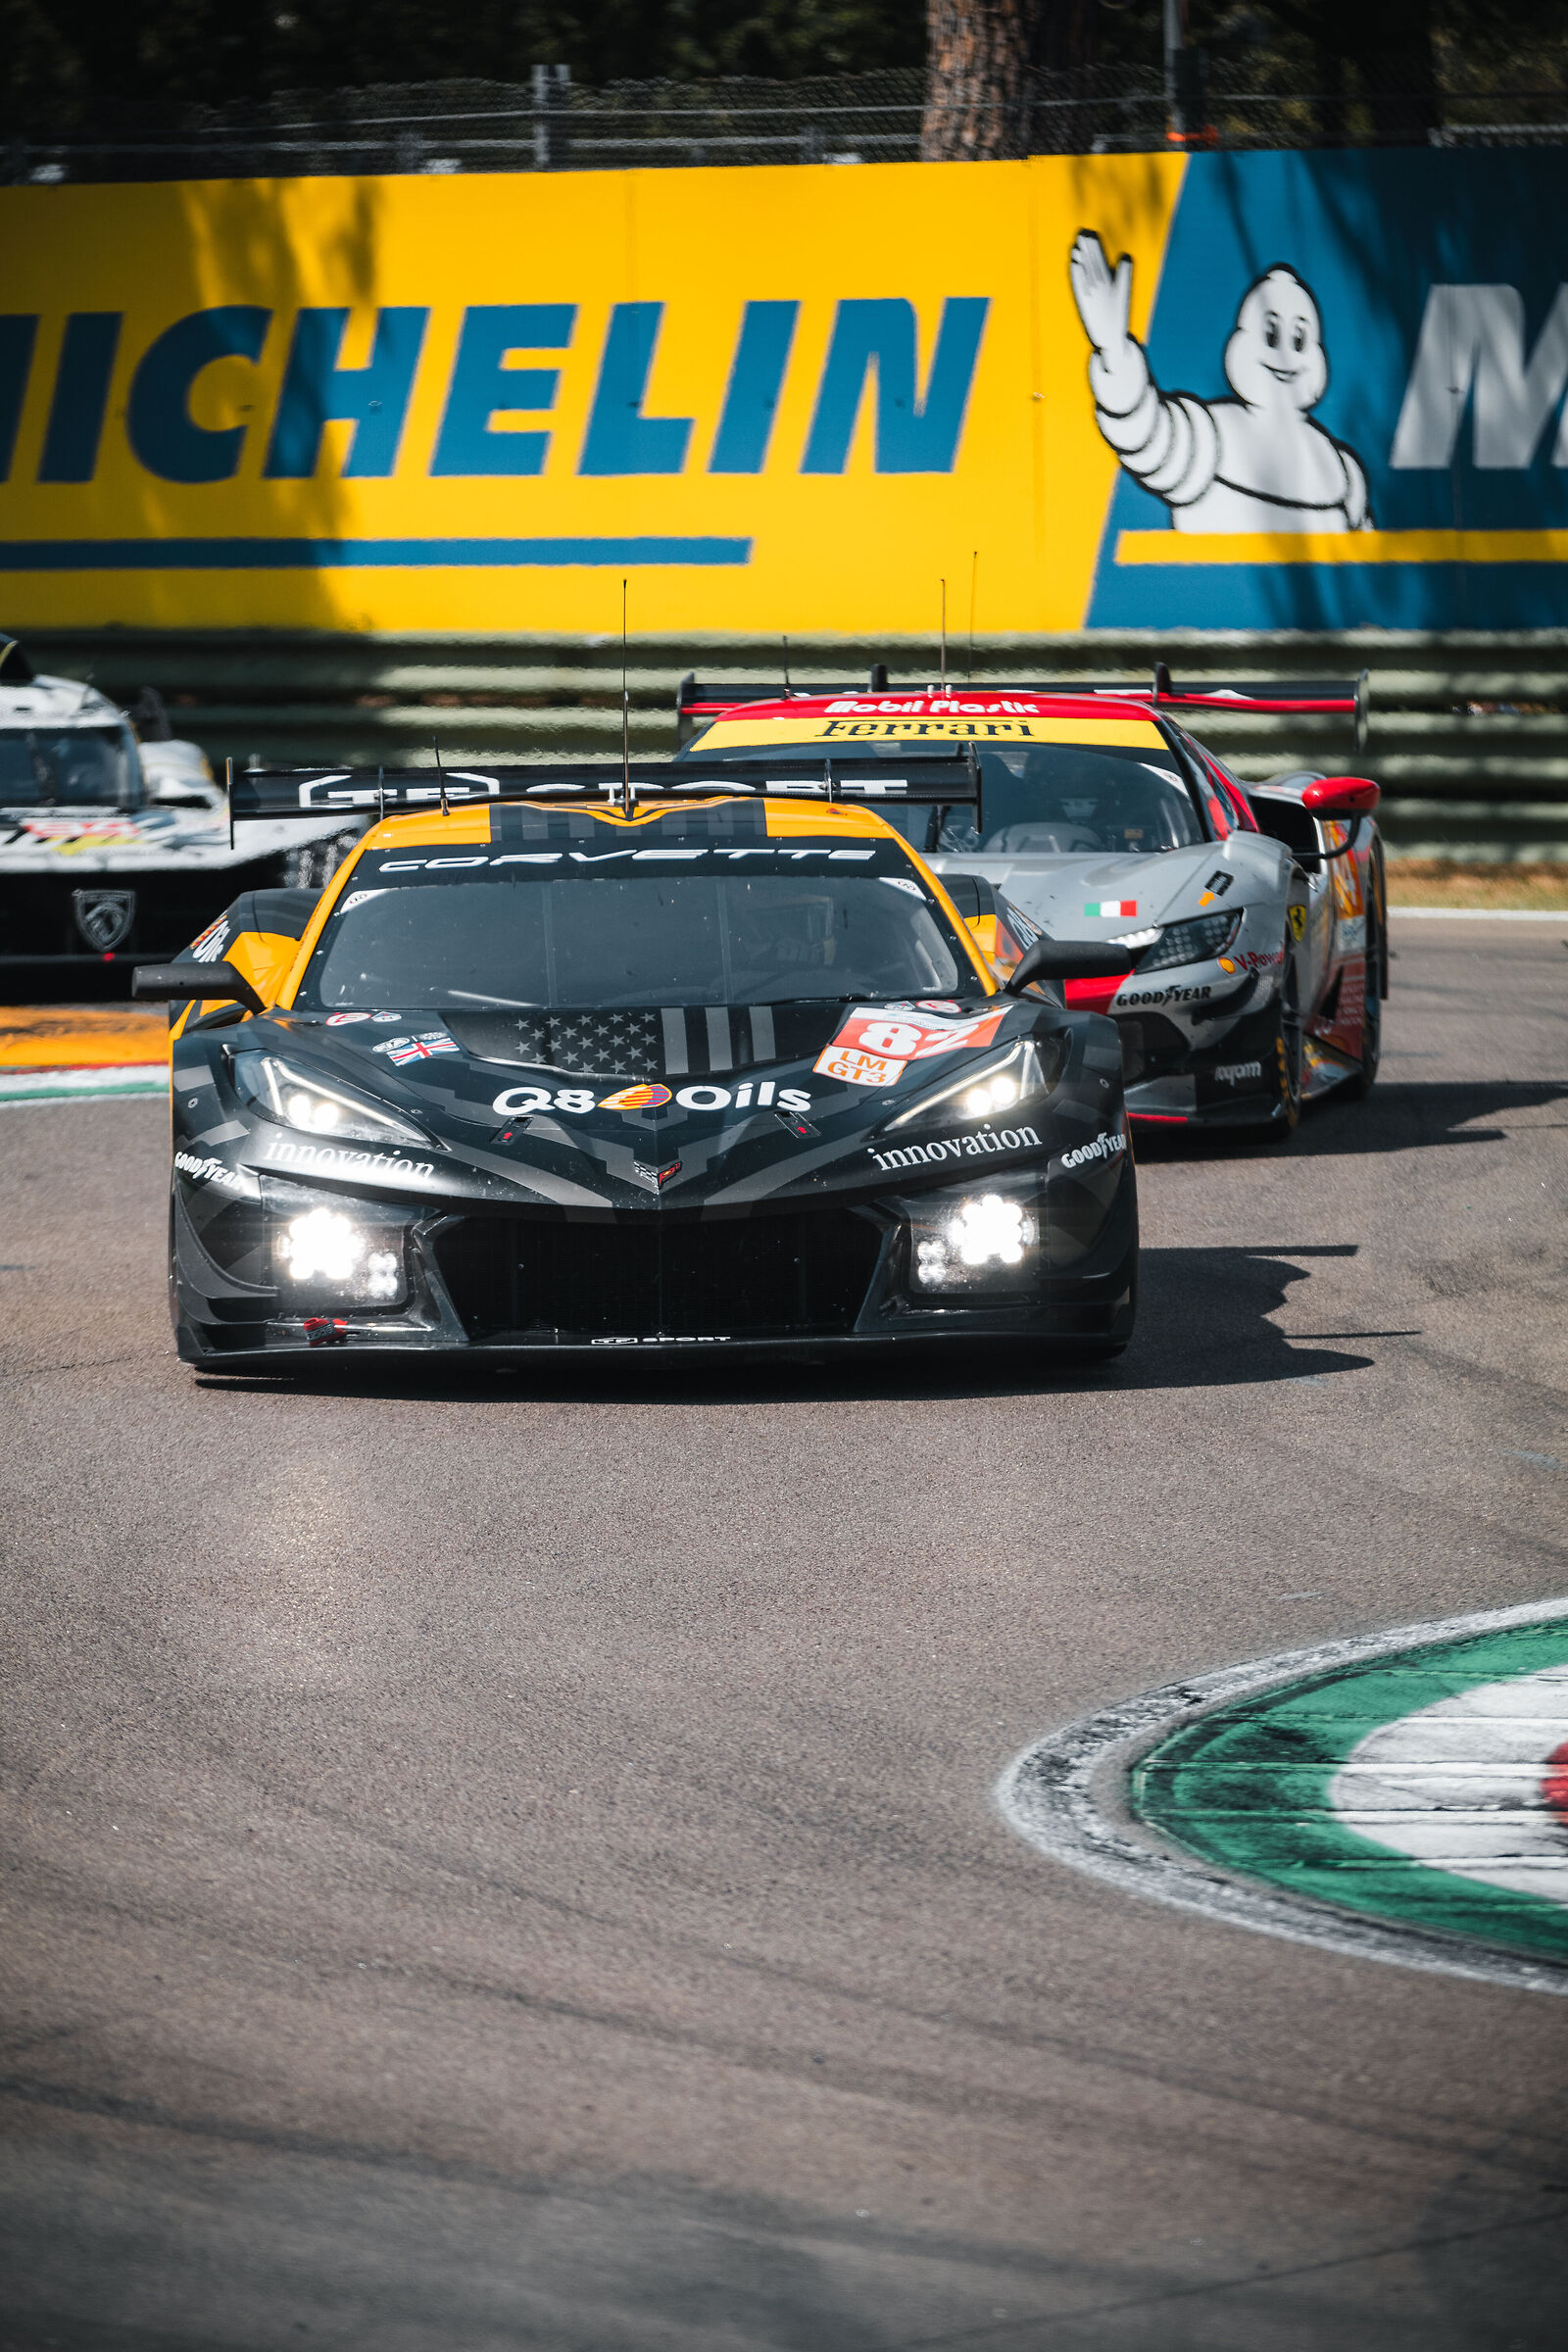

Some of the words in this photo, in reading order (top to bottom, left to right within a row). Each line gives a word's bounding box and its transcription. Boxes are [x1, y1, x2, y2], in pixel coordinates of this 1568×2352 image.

[0, 296, 991, 484] ICHELIN
[824, 700, 924, 713] Mobil
[930, 700, 1040, 713] Plastic
[815, 720, 1035, 737] Ferrari
[378, 848, 877, 874] CORVETTE
[1116, 984, 1211, 1007] GOODYEAR
[840, 1050, 887, 1071] LM
[827, 1062, 886, 1084] GT3
[492, 1086, 596, 1116] Q8
[675, 1081, 811, 1112] Oils
[264, 1132, 435, 1178] innovation
[867, 1123, 1043, 1171] innovation
